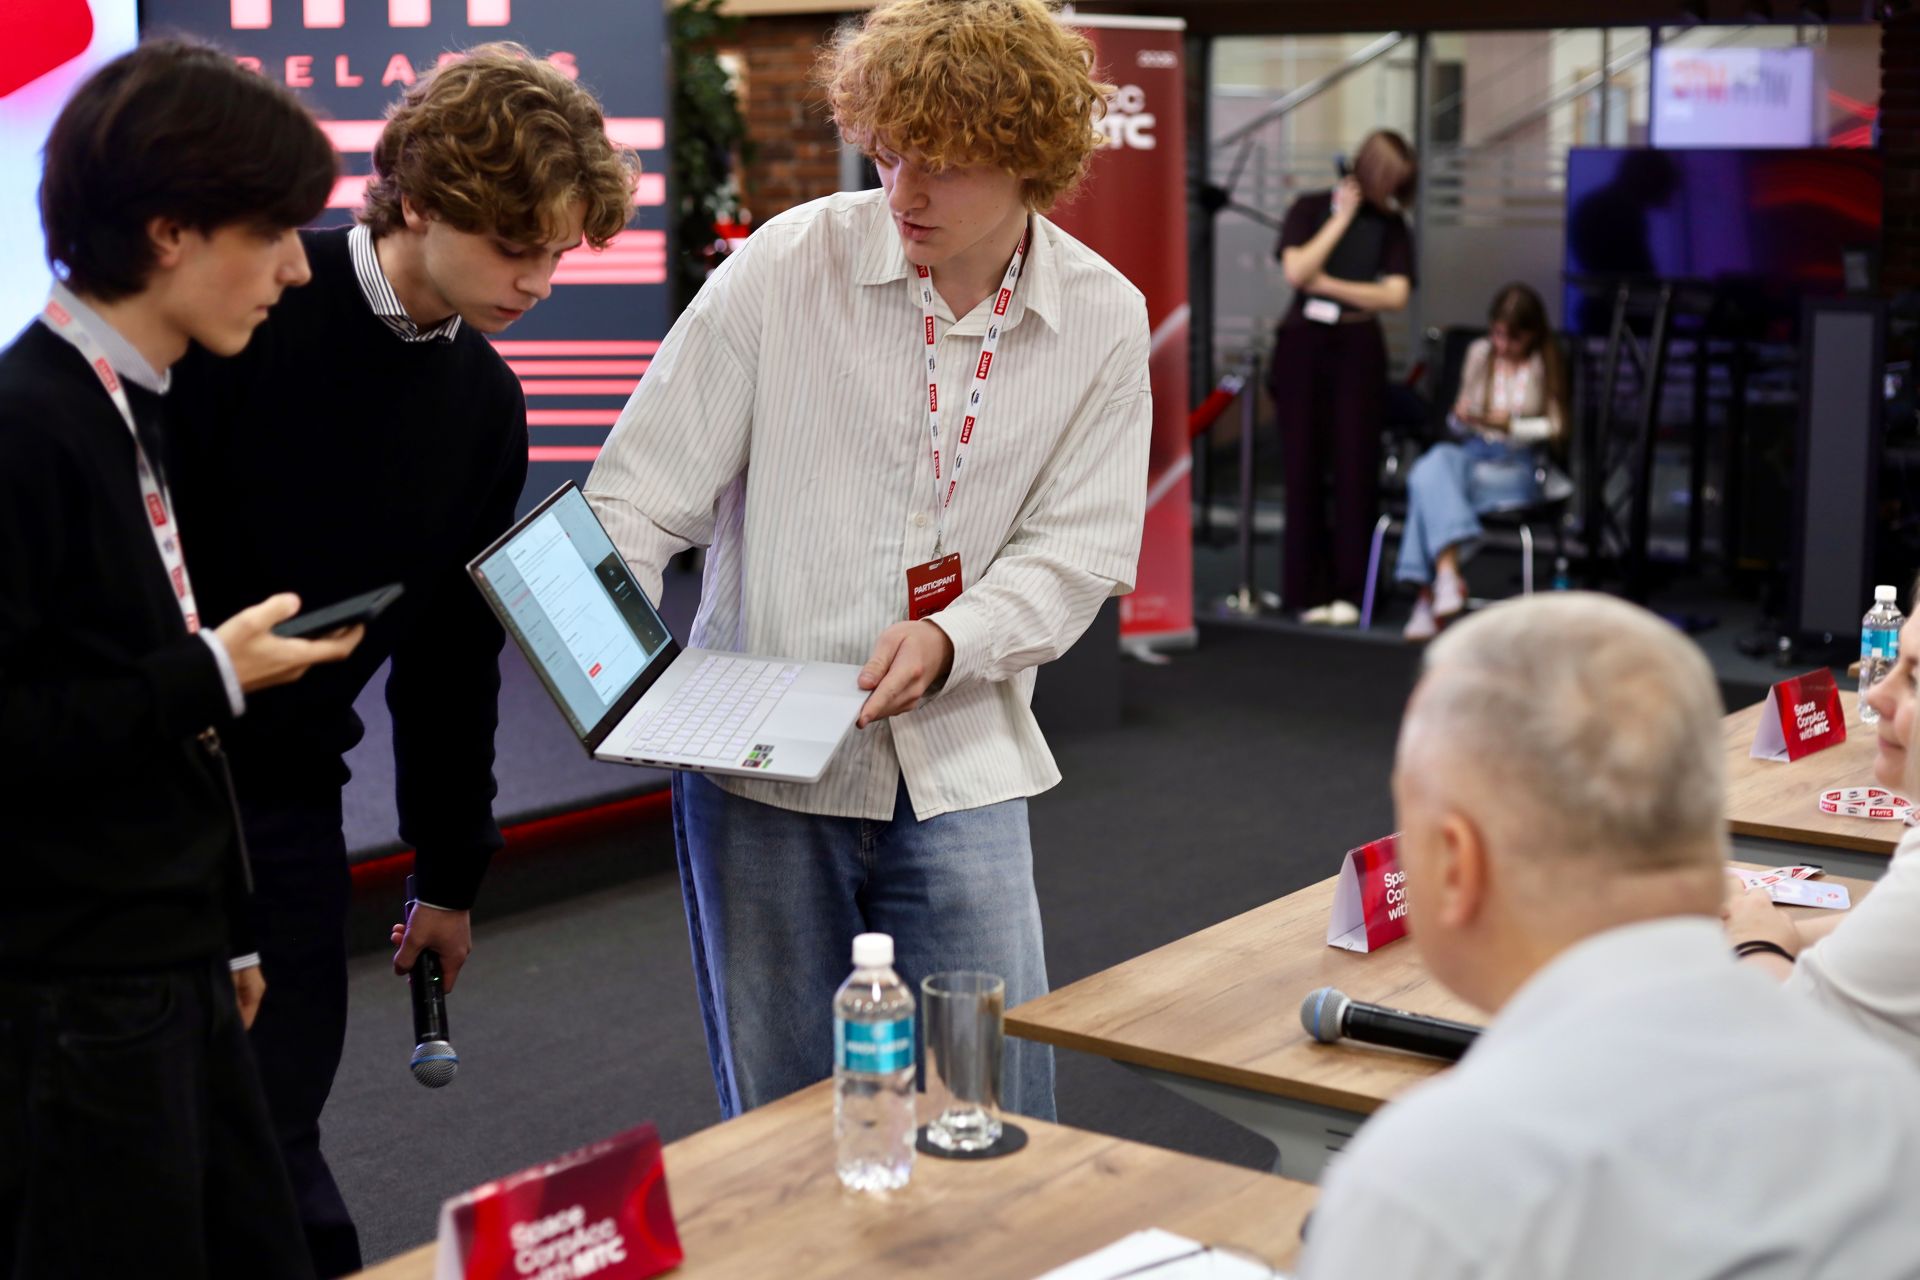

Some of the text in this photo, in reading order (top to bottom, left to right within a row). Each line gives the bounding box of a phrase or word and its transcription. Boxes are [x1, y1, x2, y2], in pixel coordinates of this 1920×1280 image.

[233, 53, 580, 88] ELAS
[998, 290, 1009, 308] MTC
[980, 353, 990, 372] MTC
[963, 418, 973, 437] MTC
[913, 573, 957, 596] PARTICIPANT
[1794, 701, 1816, 717] Space
[1797, 710, 1827, 729] CorpAcc
[1384, 870, 1407, 888] Spa
[1386, 887, 1408, 904] Cor
[510, 1204, 586, 1252] Space
